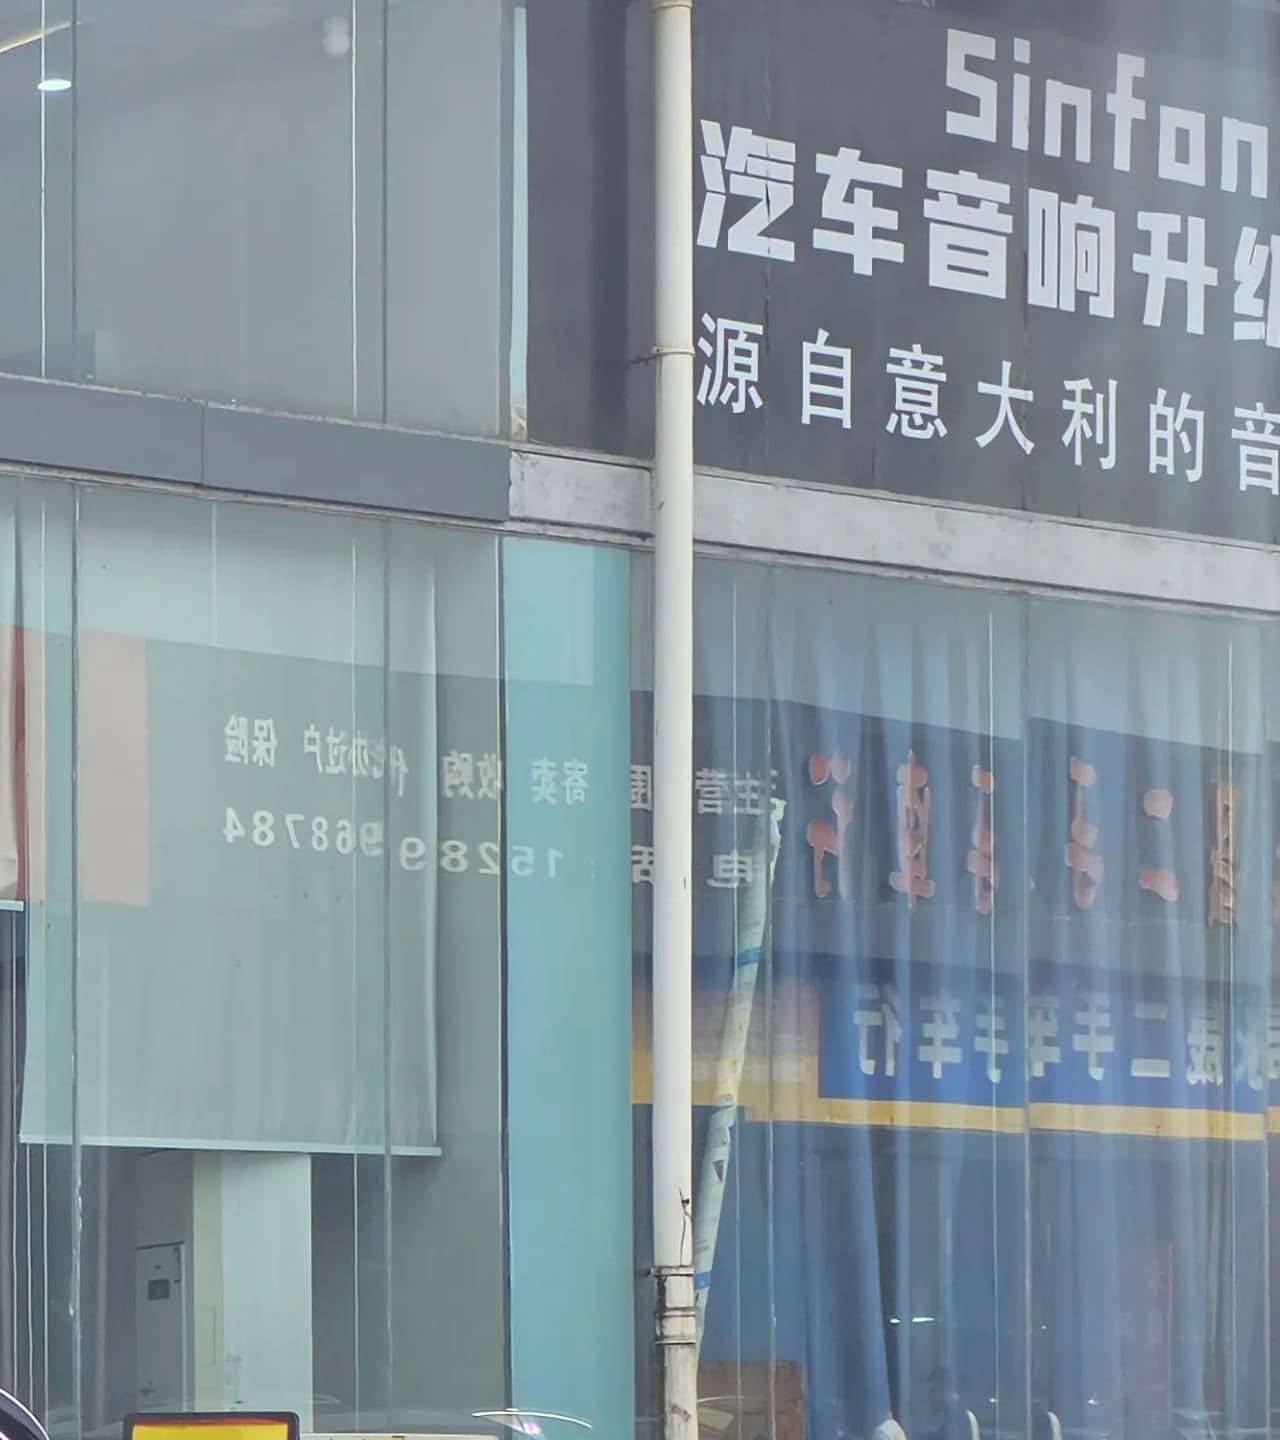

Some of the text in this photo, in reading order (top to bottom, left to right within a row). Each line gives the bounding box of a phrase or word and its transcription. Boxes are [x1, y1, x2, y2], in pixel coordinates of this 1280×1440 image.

[946, 28, 1269, 199] Sinfon
[696, 312, 1280, 495] 源自意大利的音
